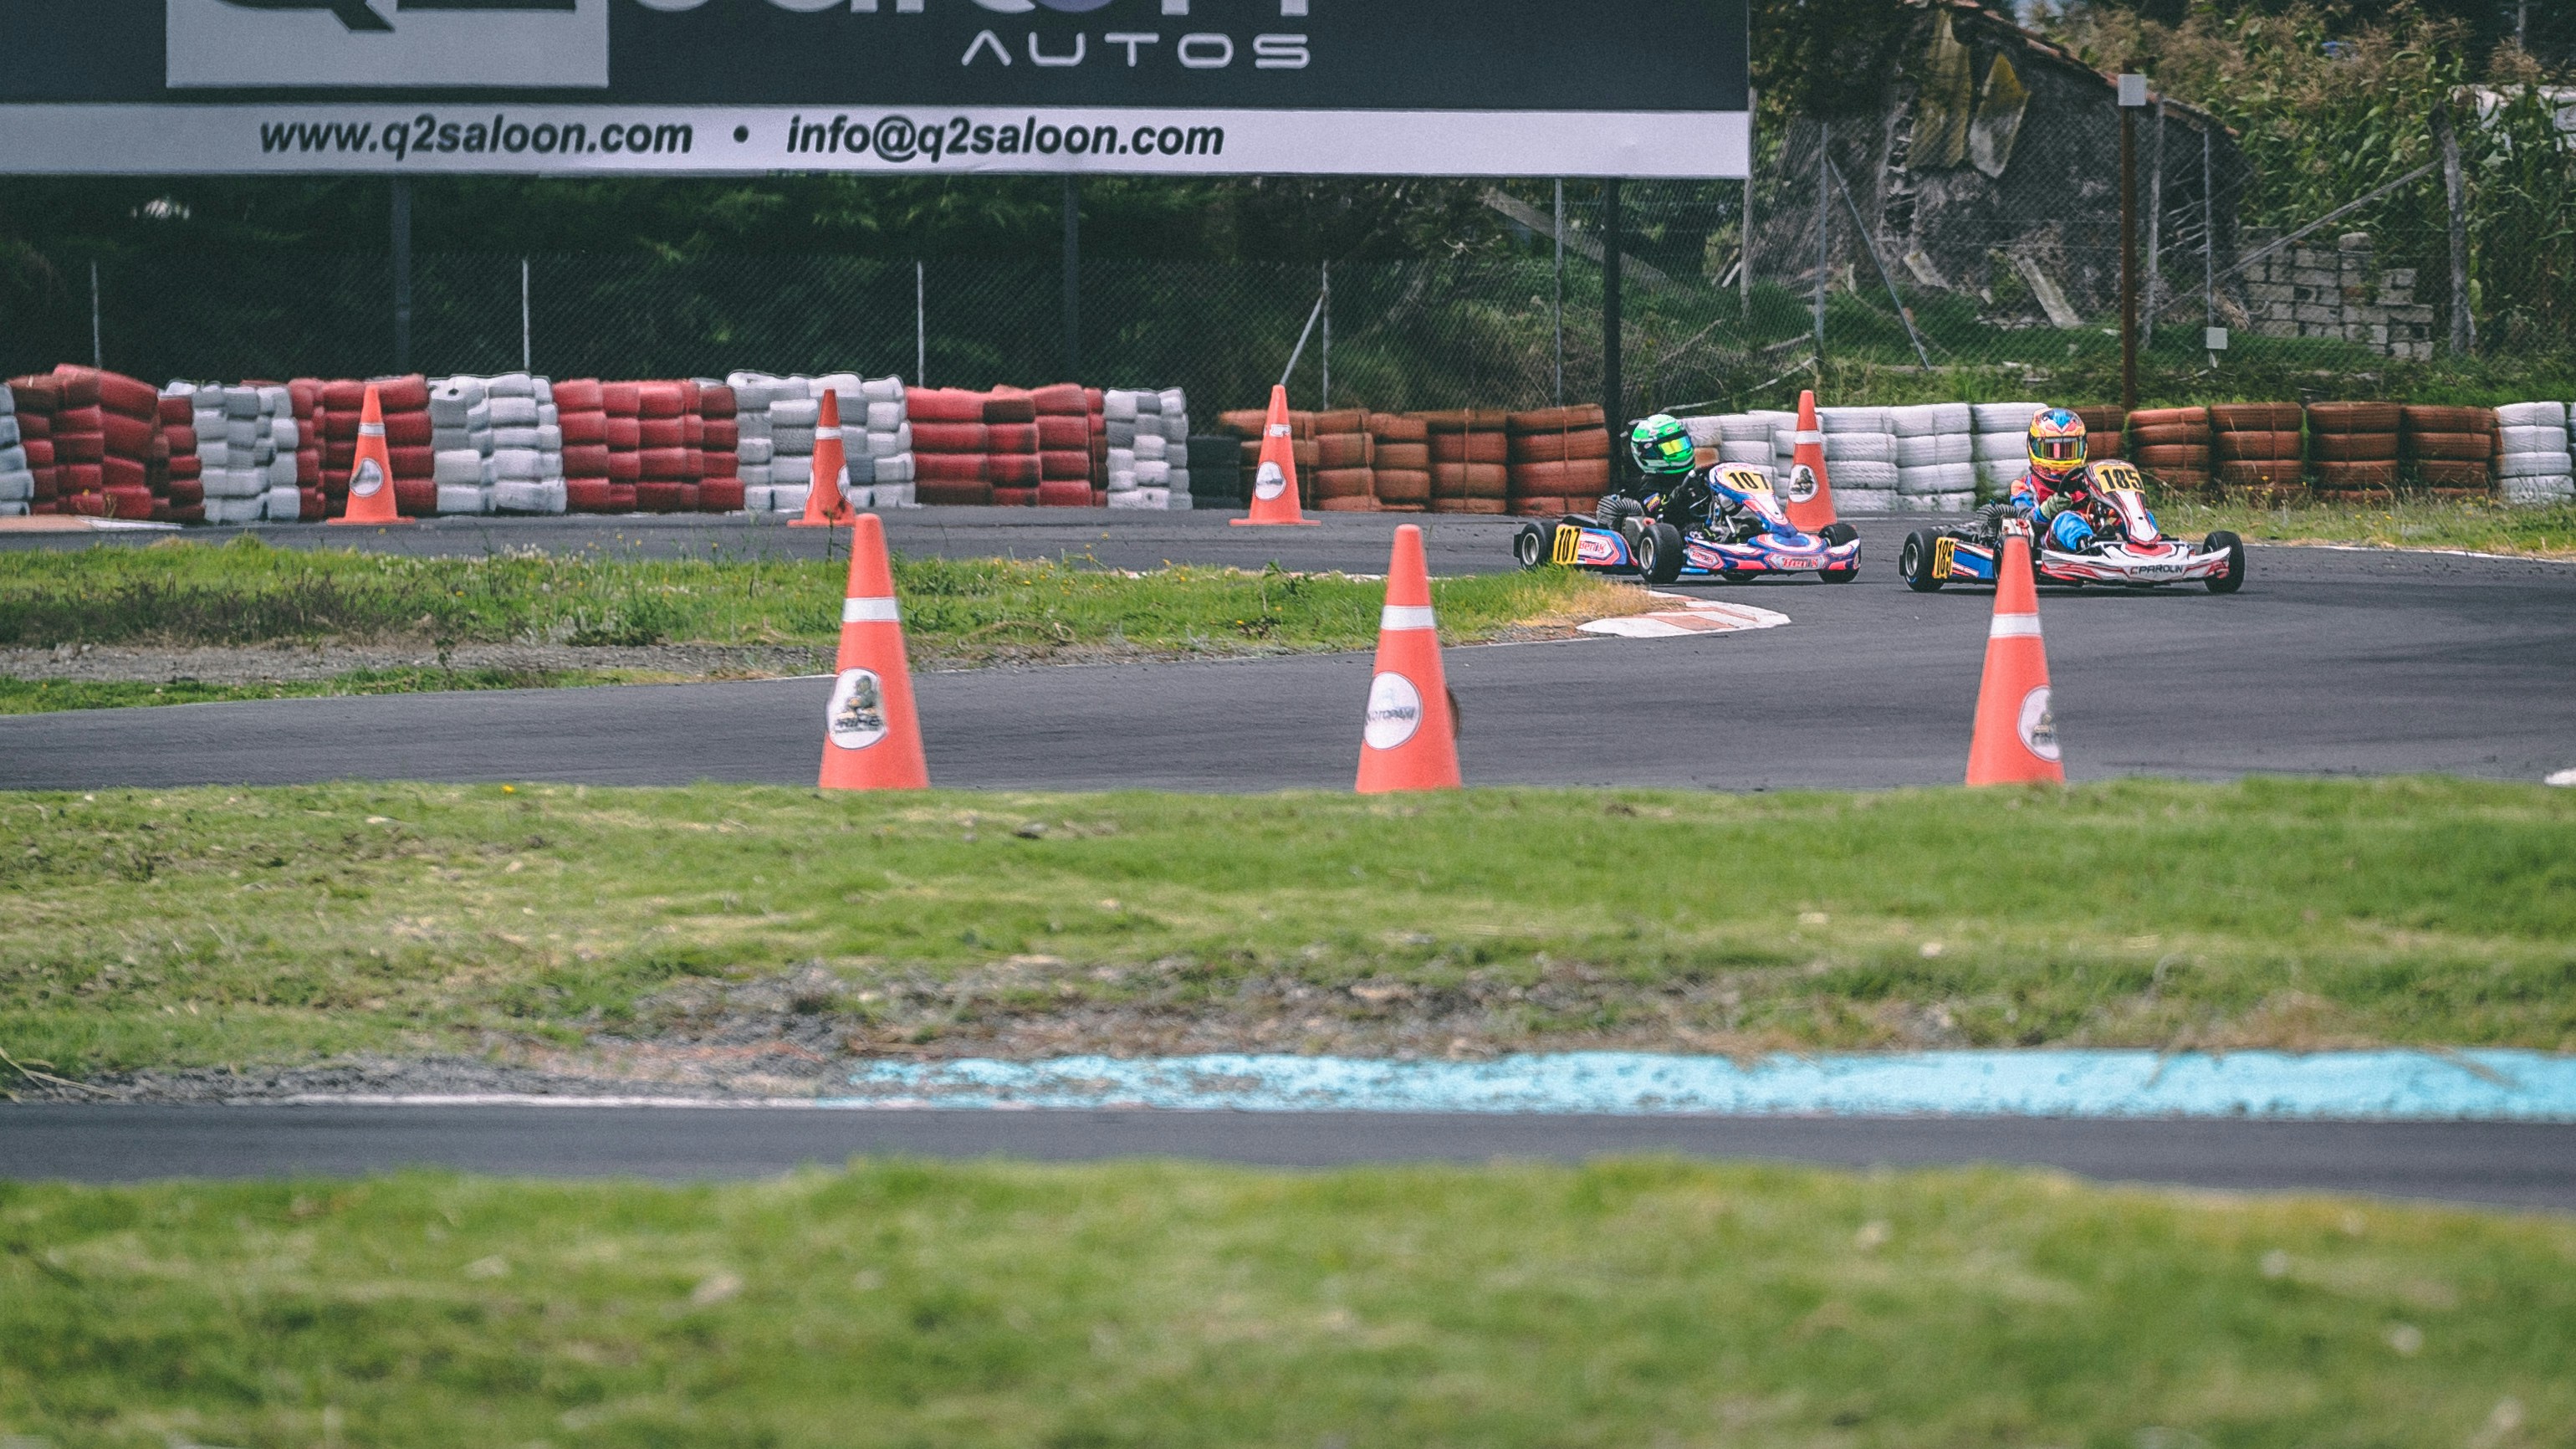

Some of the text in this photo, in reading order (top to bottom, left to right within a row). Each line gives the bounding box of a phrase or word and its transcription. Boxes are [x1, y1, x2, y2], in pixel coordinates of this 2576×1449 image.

[961, 29, 1311, 69] AUTOS
[260, 113, 1225, 163] www.q2saloon.com info@q2saloon.com
[1728, 471, 1770, 490] 107
[2100, 468, 2143, 490] 185
[1556, 527, 1581, 562] 107
[1935, 540, 1955, 576] 185
